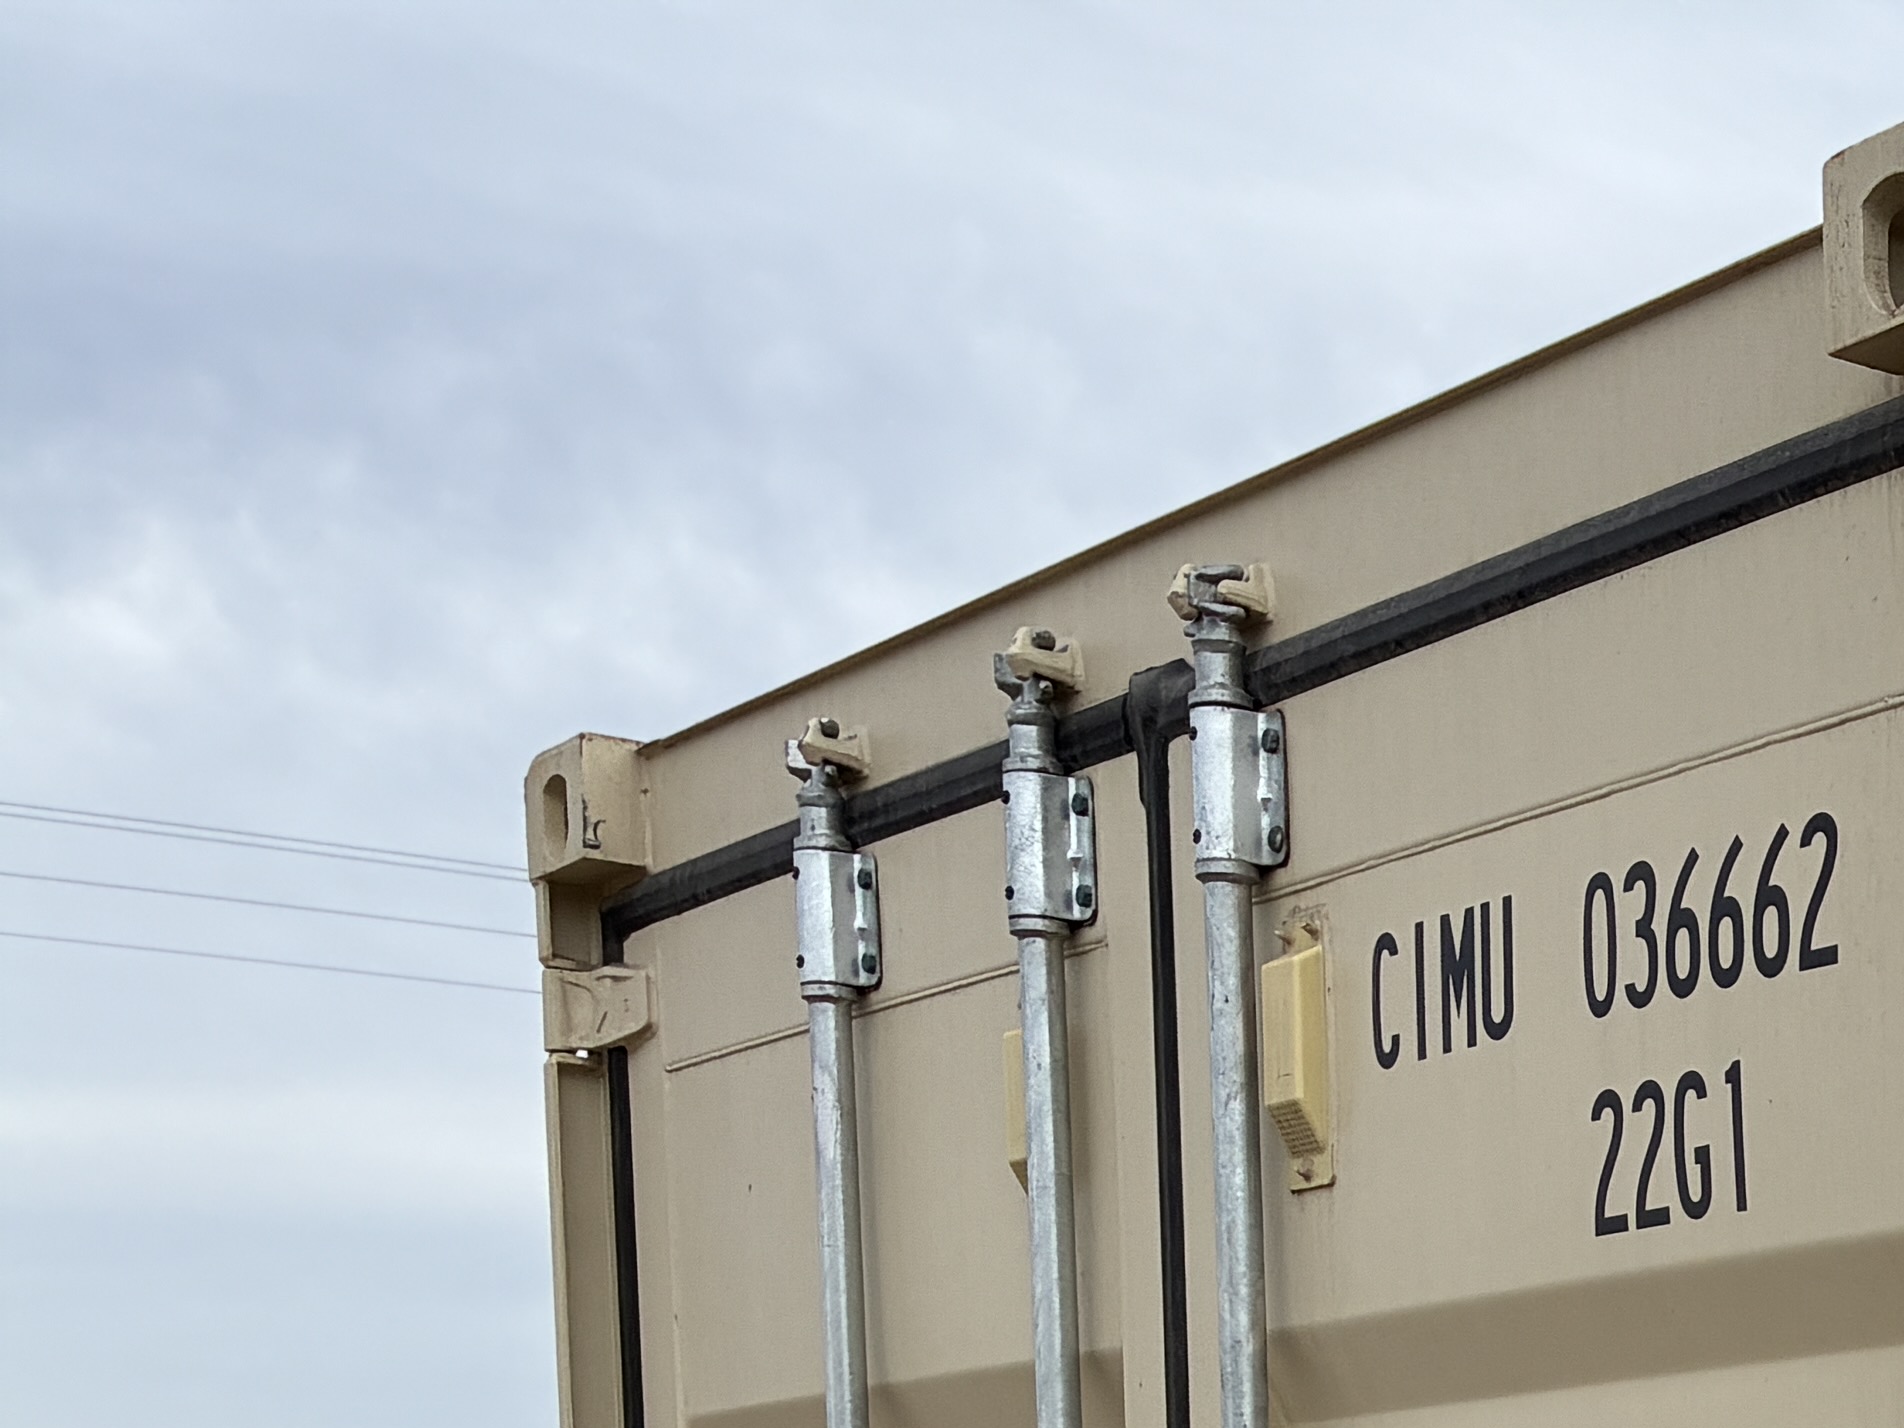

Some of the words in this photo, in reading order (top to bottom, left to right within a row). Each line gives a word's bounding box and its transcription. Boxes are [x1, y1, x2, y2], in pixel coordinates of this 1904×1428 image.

[1372, 895, 1513, 1069] CIMU
[1583, 812, 1838, 1018] 036662
[1591, 1060, 1747, 1237] 22G1
